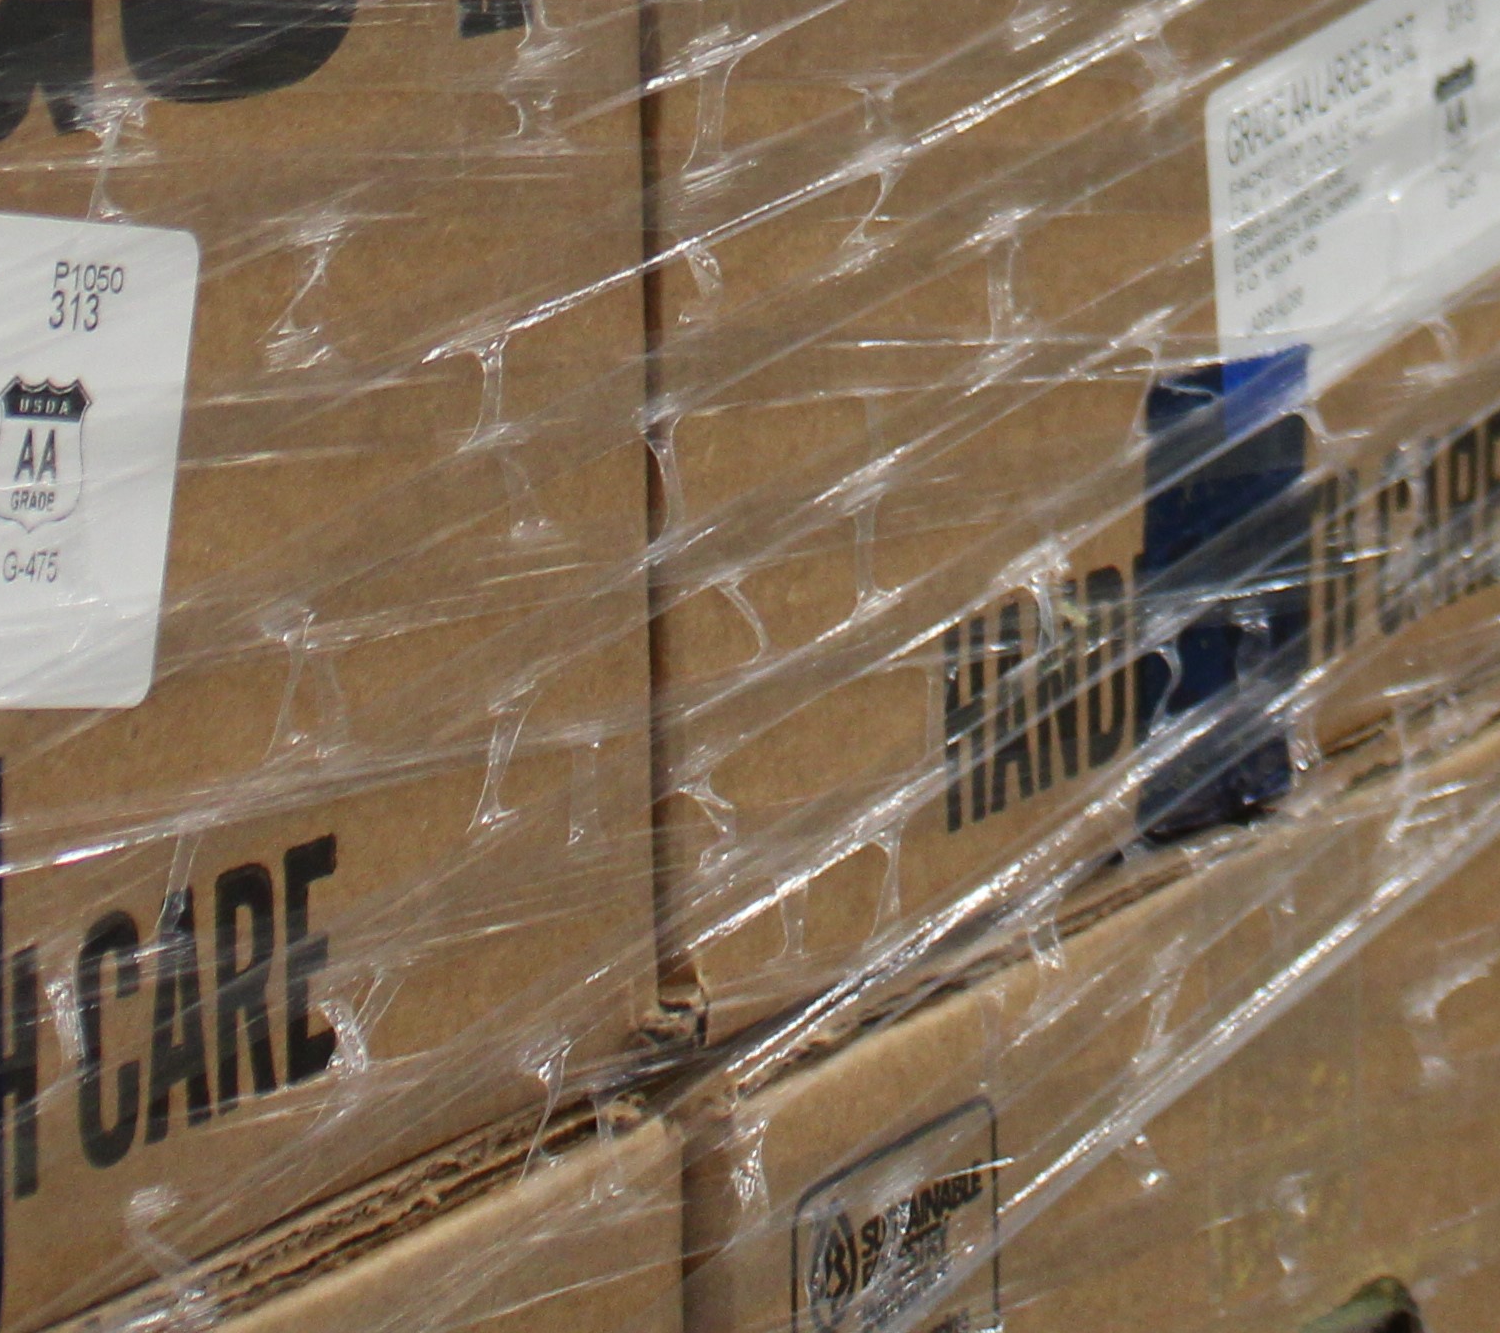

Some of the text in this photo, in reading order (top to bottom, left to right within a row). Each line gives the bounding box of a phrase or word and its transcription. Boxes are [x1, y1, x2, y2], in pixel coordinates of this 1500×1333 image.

[53, 261, 125, 294] P1050
[48, 290, 100, 332] 313
[18, 397, 70, 415] USDA
[13, 427, 58, 483] AA
[10, 489, 56, 512] GRADE
[2, 550, 59, 583] G-475
[943, 555, 1141, 833] HAND
[74, 833, 338, 1170] CARE
